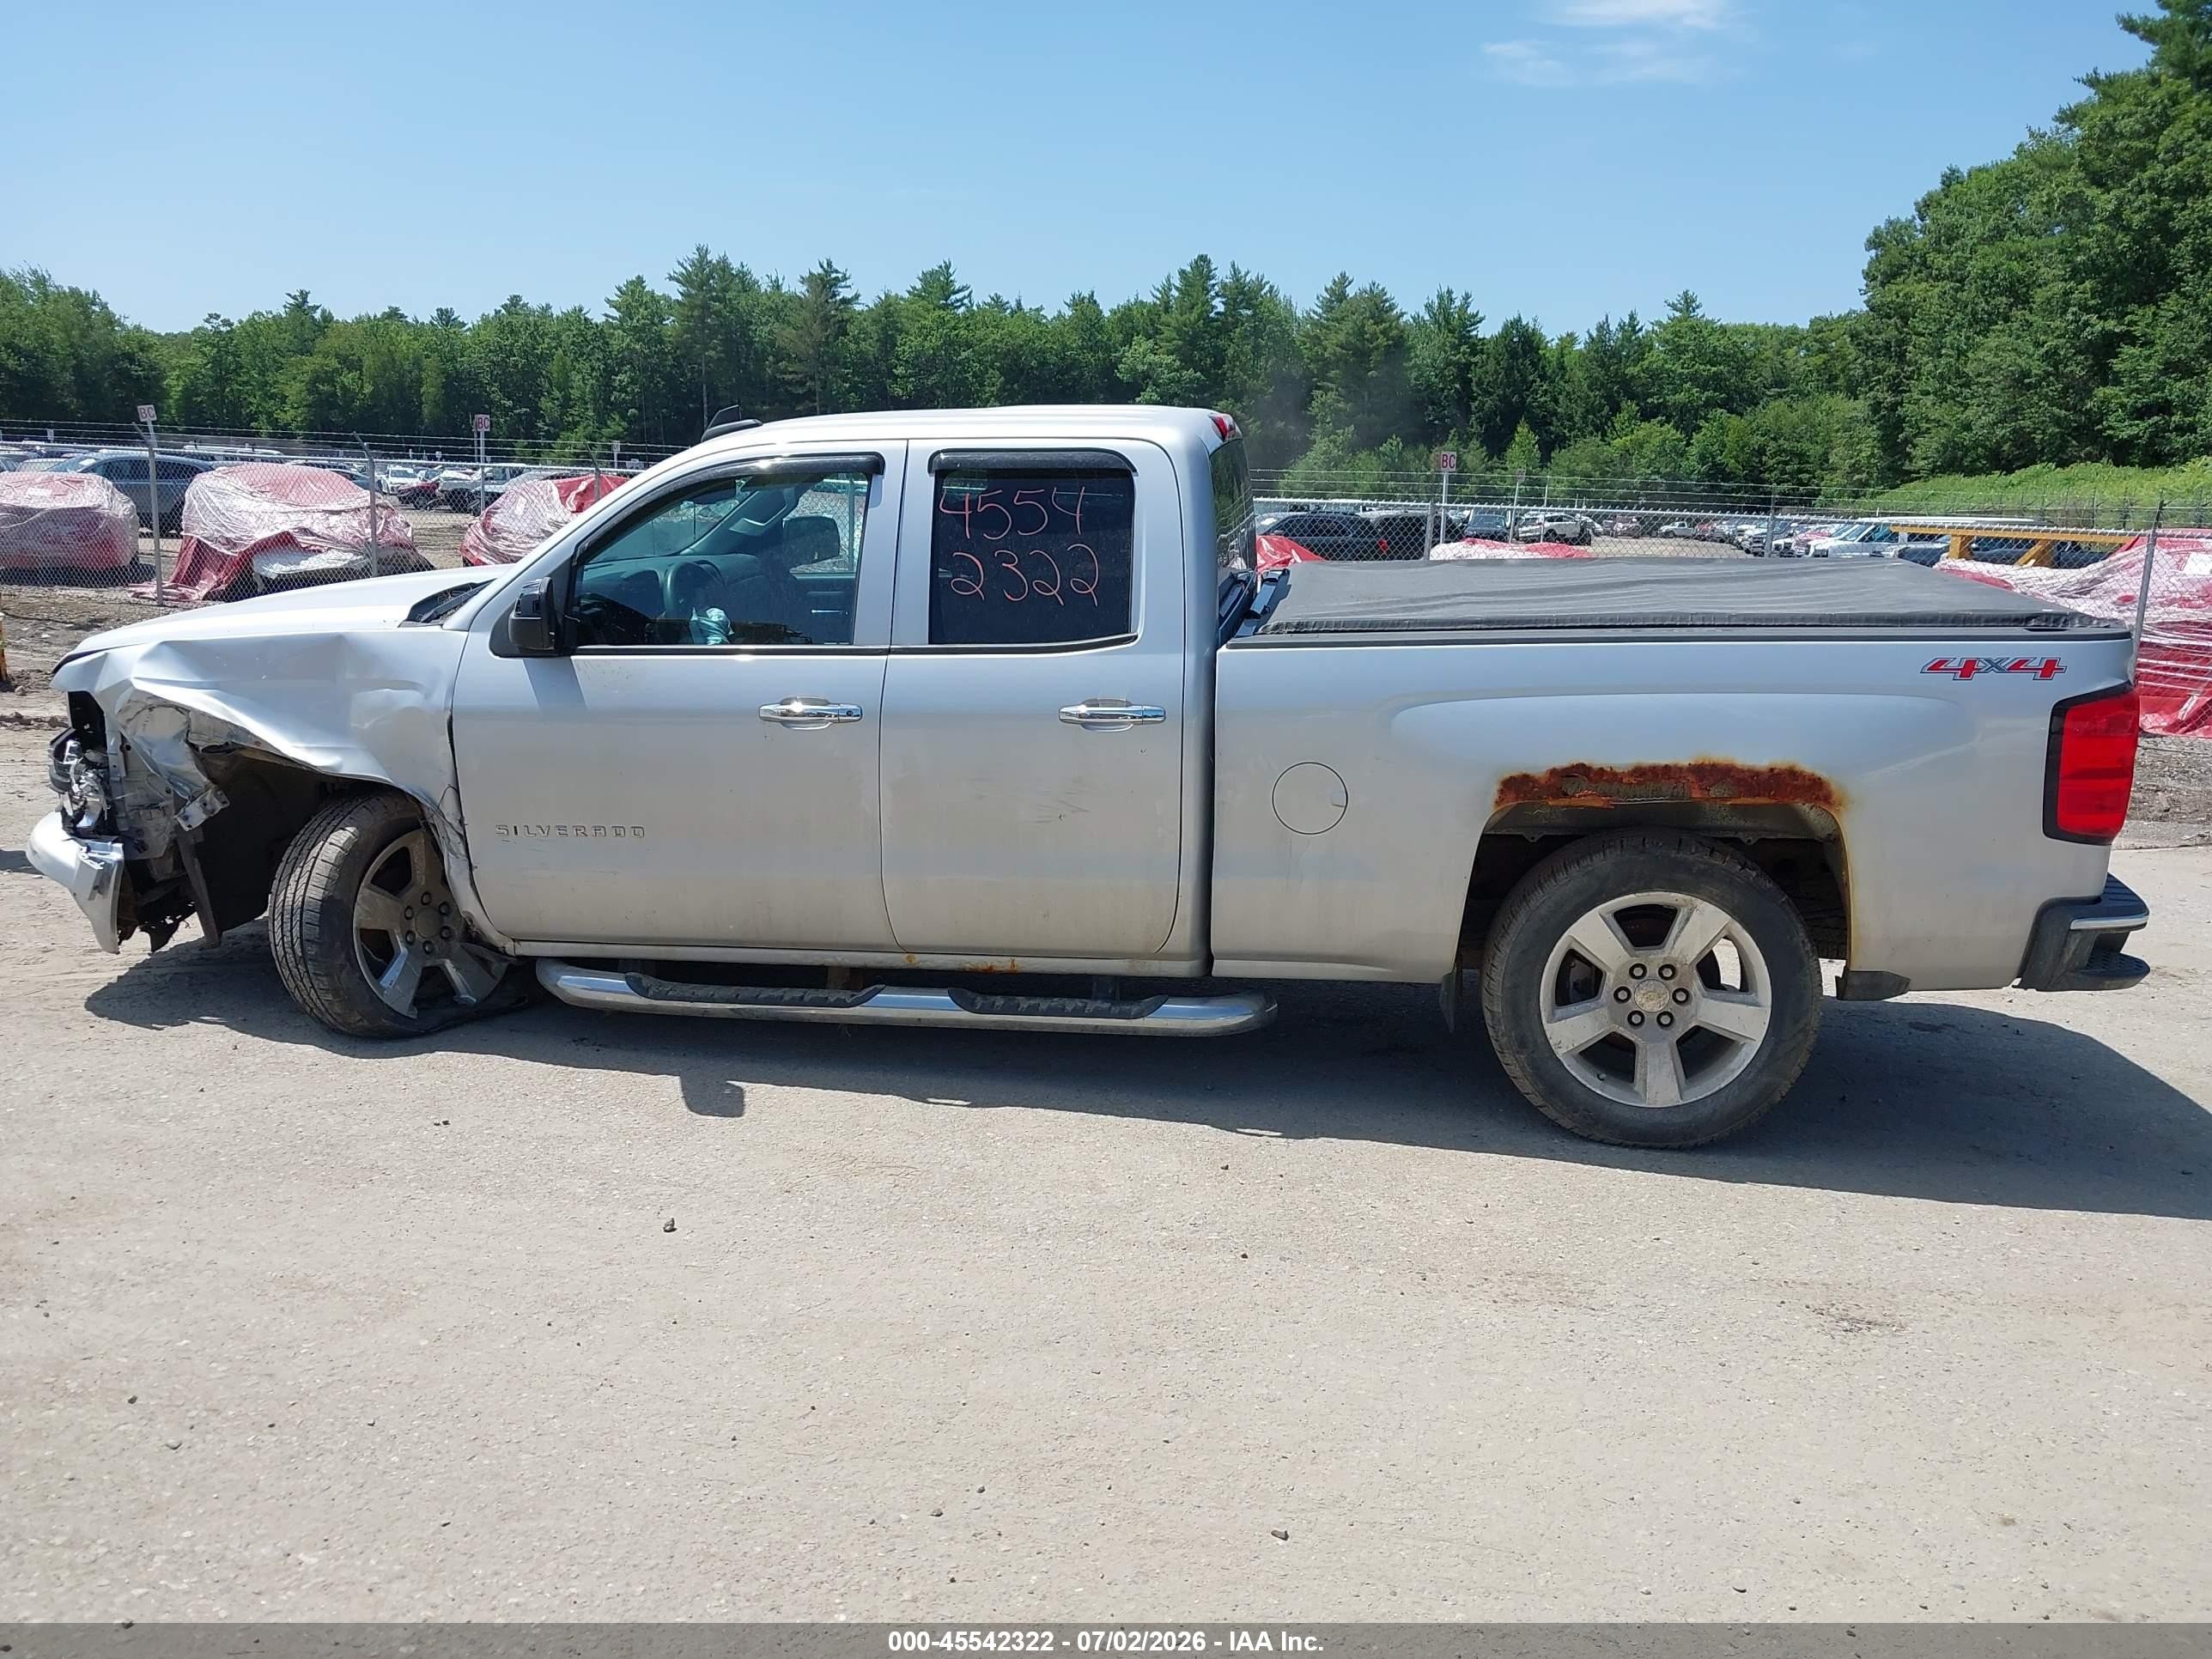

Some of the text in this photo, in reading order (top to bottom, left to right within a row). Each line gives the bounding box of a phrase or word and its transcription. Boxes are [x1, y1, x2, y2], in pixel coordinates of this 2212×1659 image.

[139, 407, 155, 419] BC
[477, 417, 489, 429] BC
[1442, 453, 1456, 469] BC
[939, 486, 1085, 540] 4554
[950, 544, 1100, 607] 2322
[494, 824, 646, 839] SILVERADO
